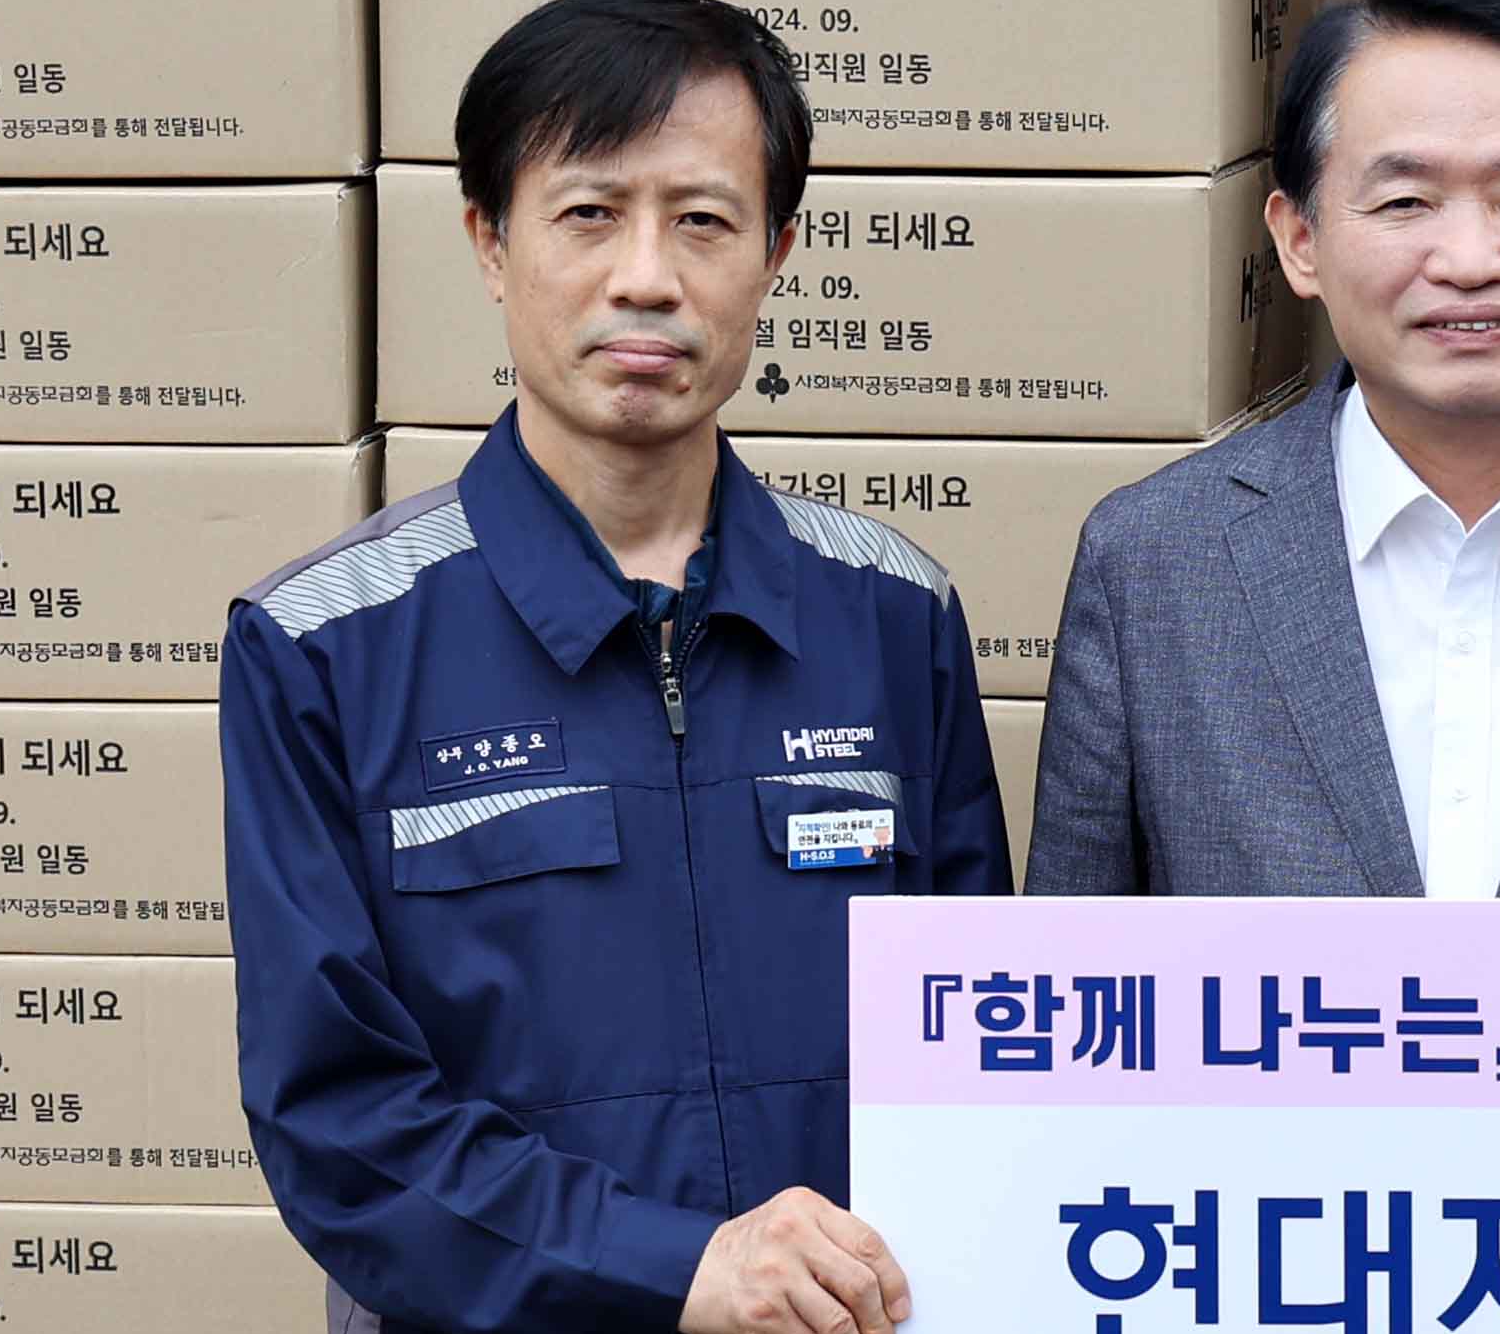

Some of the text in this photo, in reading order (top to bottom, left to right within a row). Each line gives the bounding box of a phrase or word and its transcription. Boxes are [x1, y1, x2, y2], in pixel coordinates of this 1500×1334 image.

[812, 726, 874, 743] HYUNDAI
[815, 743, 862, 758] STEEL
[493, 756, 529, 770] YANG
[11, 1236, 118, 1276] 되세요
